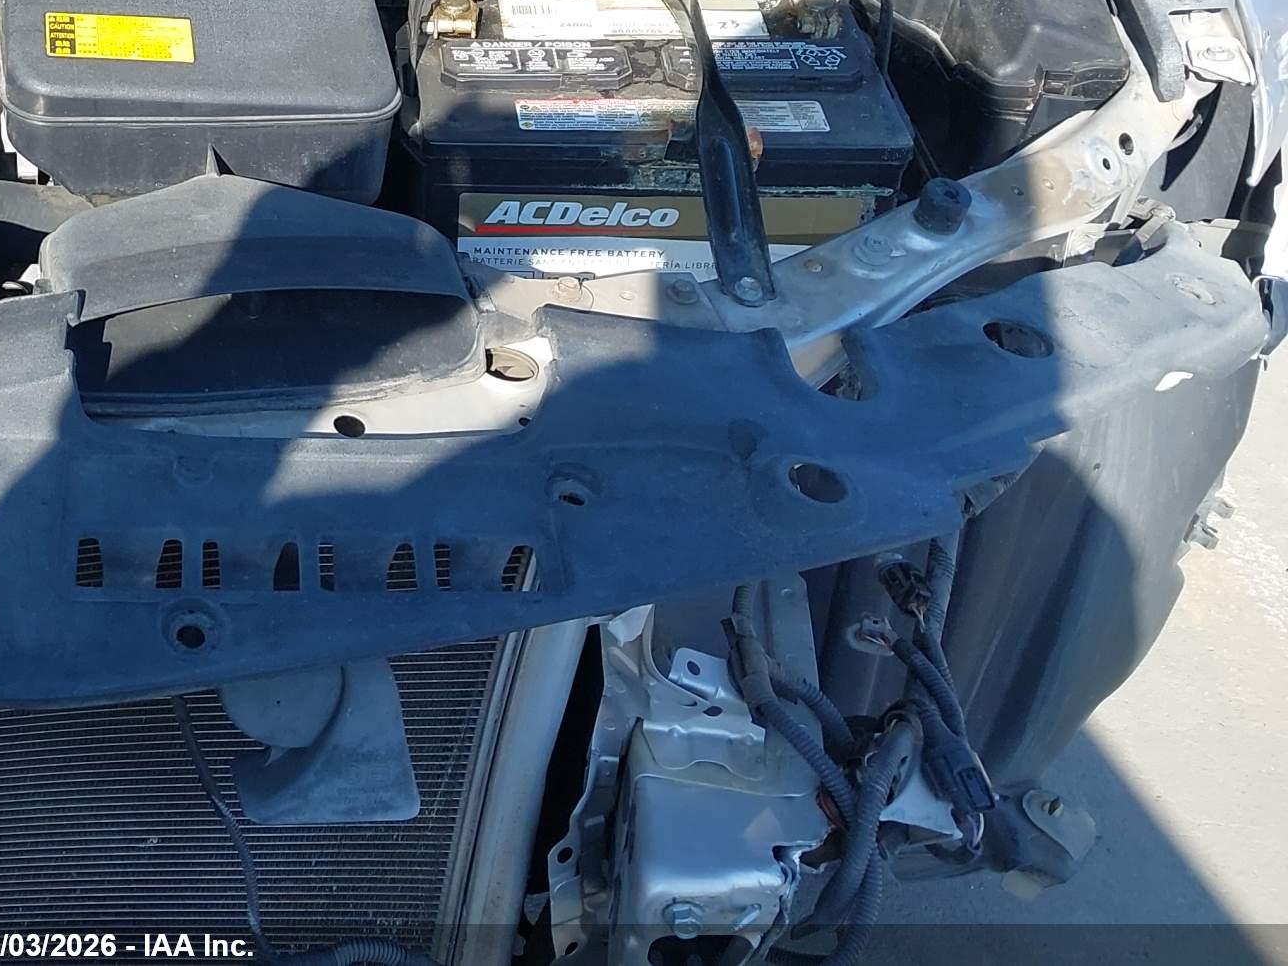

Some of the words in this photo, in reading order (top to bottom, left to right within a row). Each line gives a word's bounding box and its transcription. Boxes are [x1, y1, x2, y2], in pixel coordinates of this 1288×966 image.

[483, 200, 681, 228] ACDelco
[473, 247, 566, 256] MAINTENANCE
[570, 249, 602, 257] FREE
[607, 249, 666, 259] BATTERY
